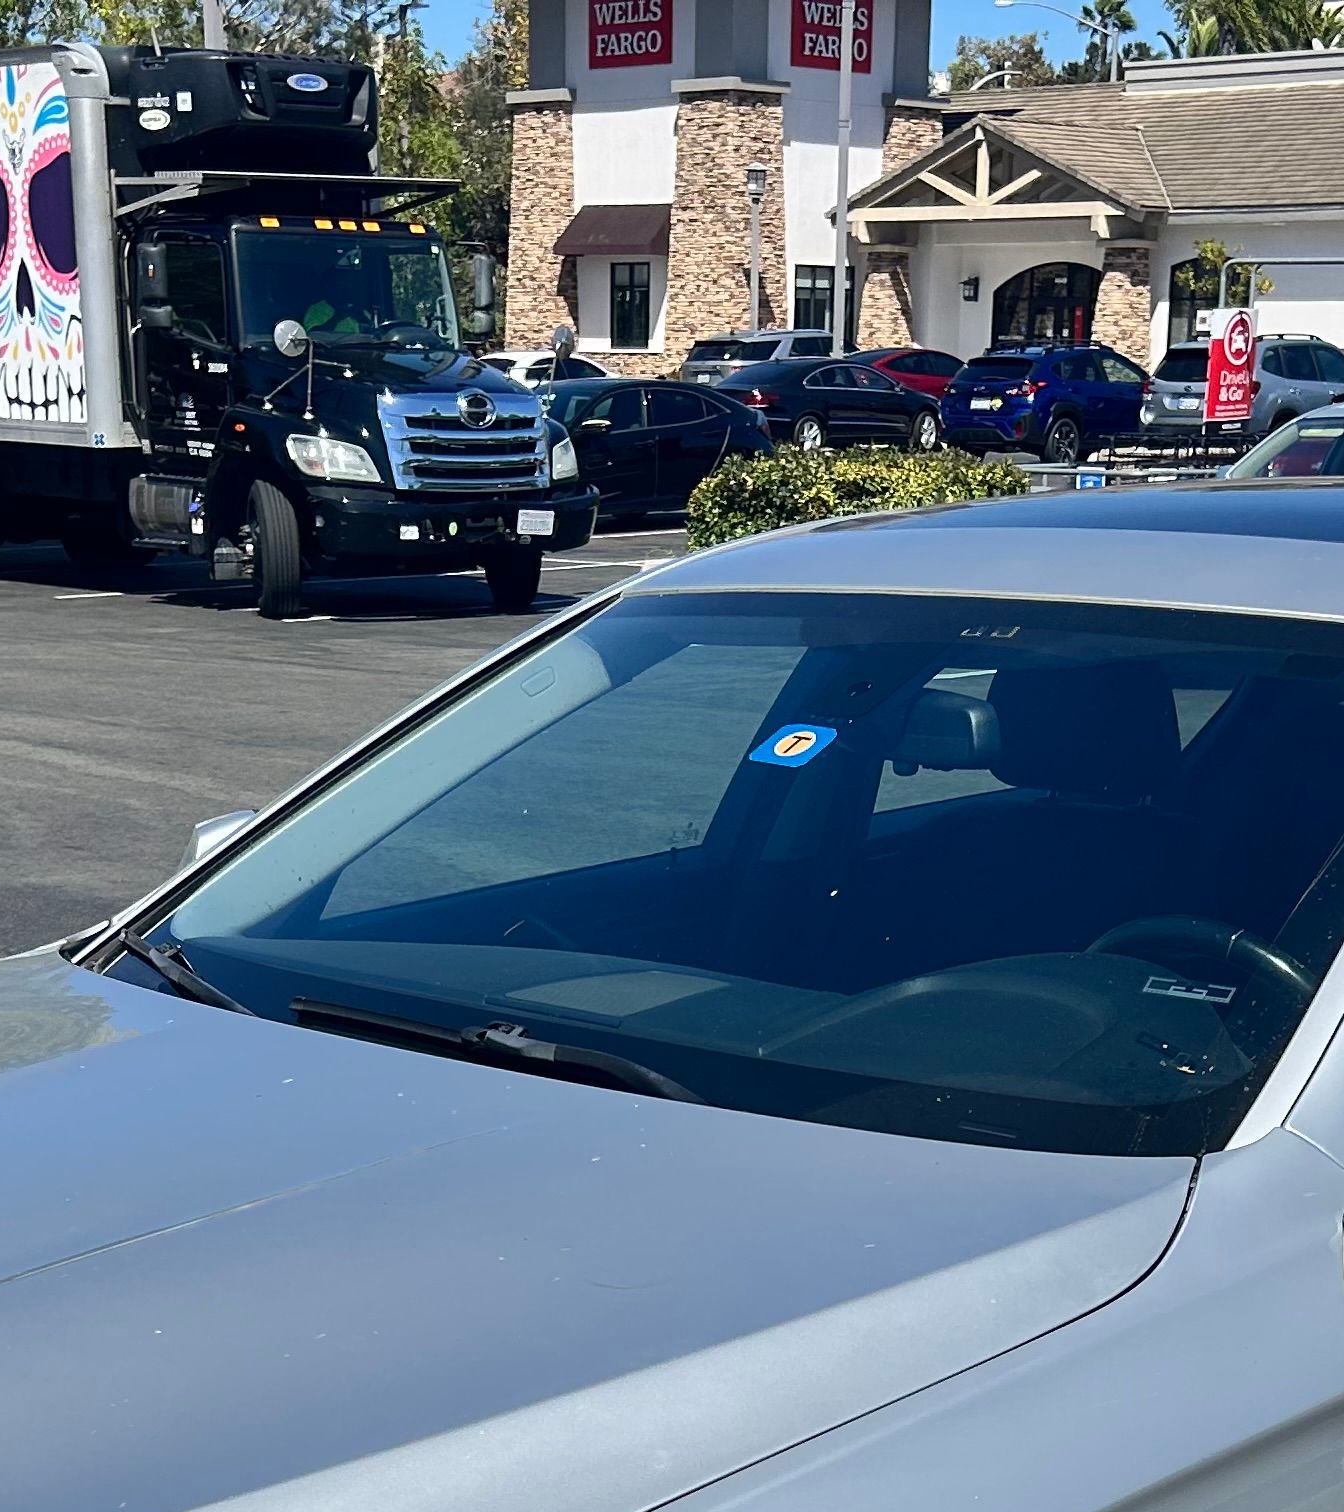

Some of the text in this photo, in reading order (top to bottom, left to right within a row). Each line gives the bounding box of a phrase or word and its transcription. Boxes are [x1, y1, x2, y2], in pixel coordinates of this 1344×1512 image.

[594, 0, 662, 26] WELLS
[596, 30, 662, 56] FARGO
[804, 32, 868, 61] FARO
[1219, 387, 1229, 402] &
